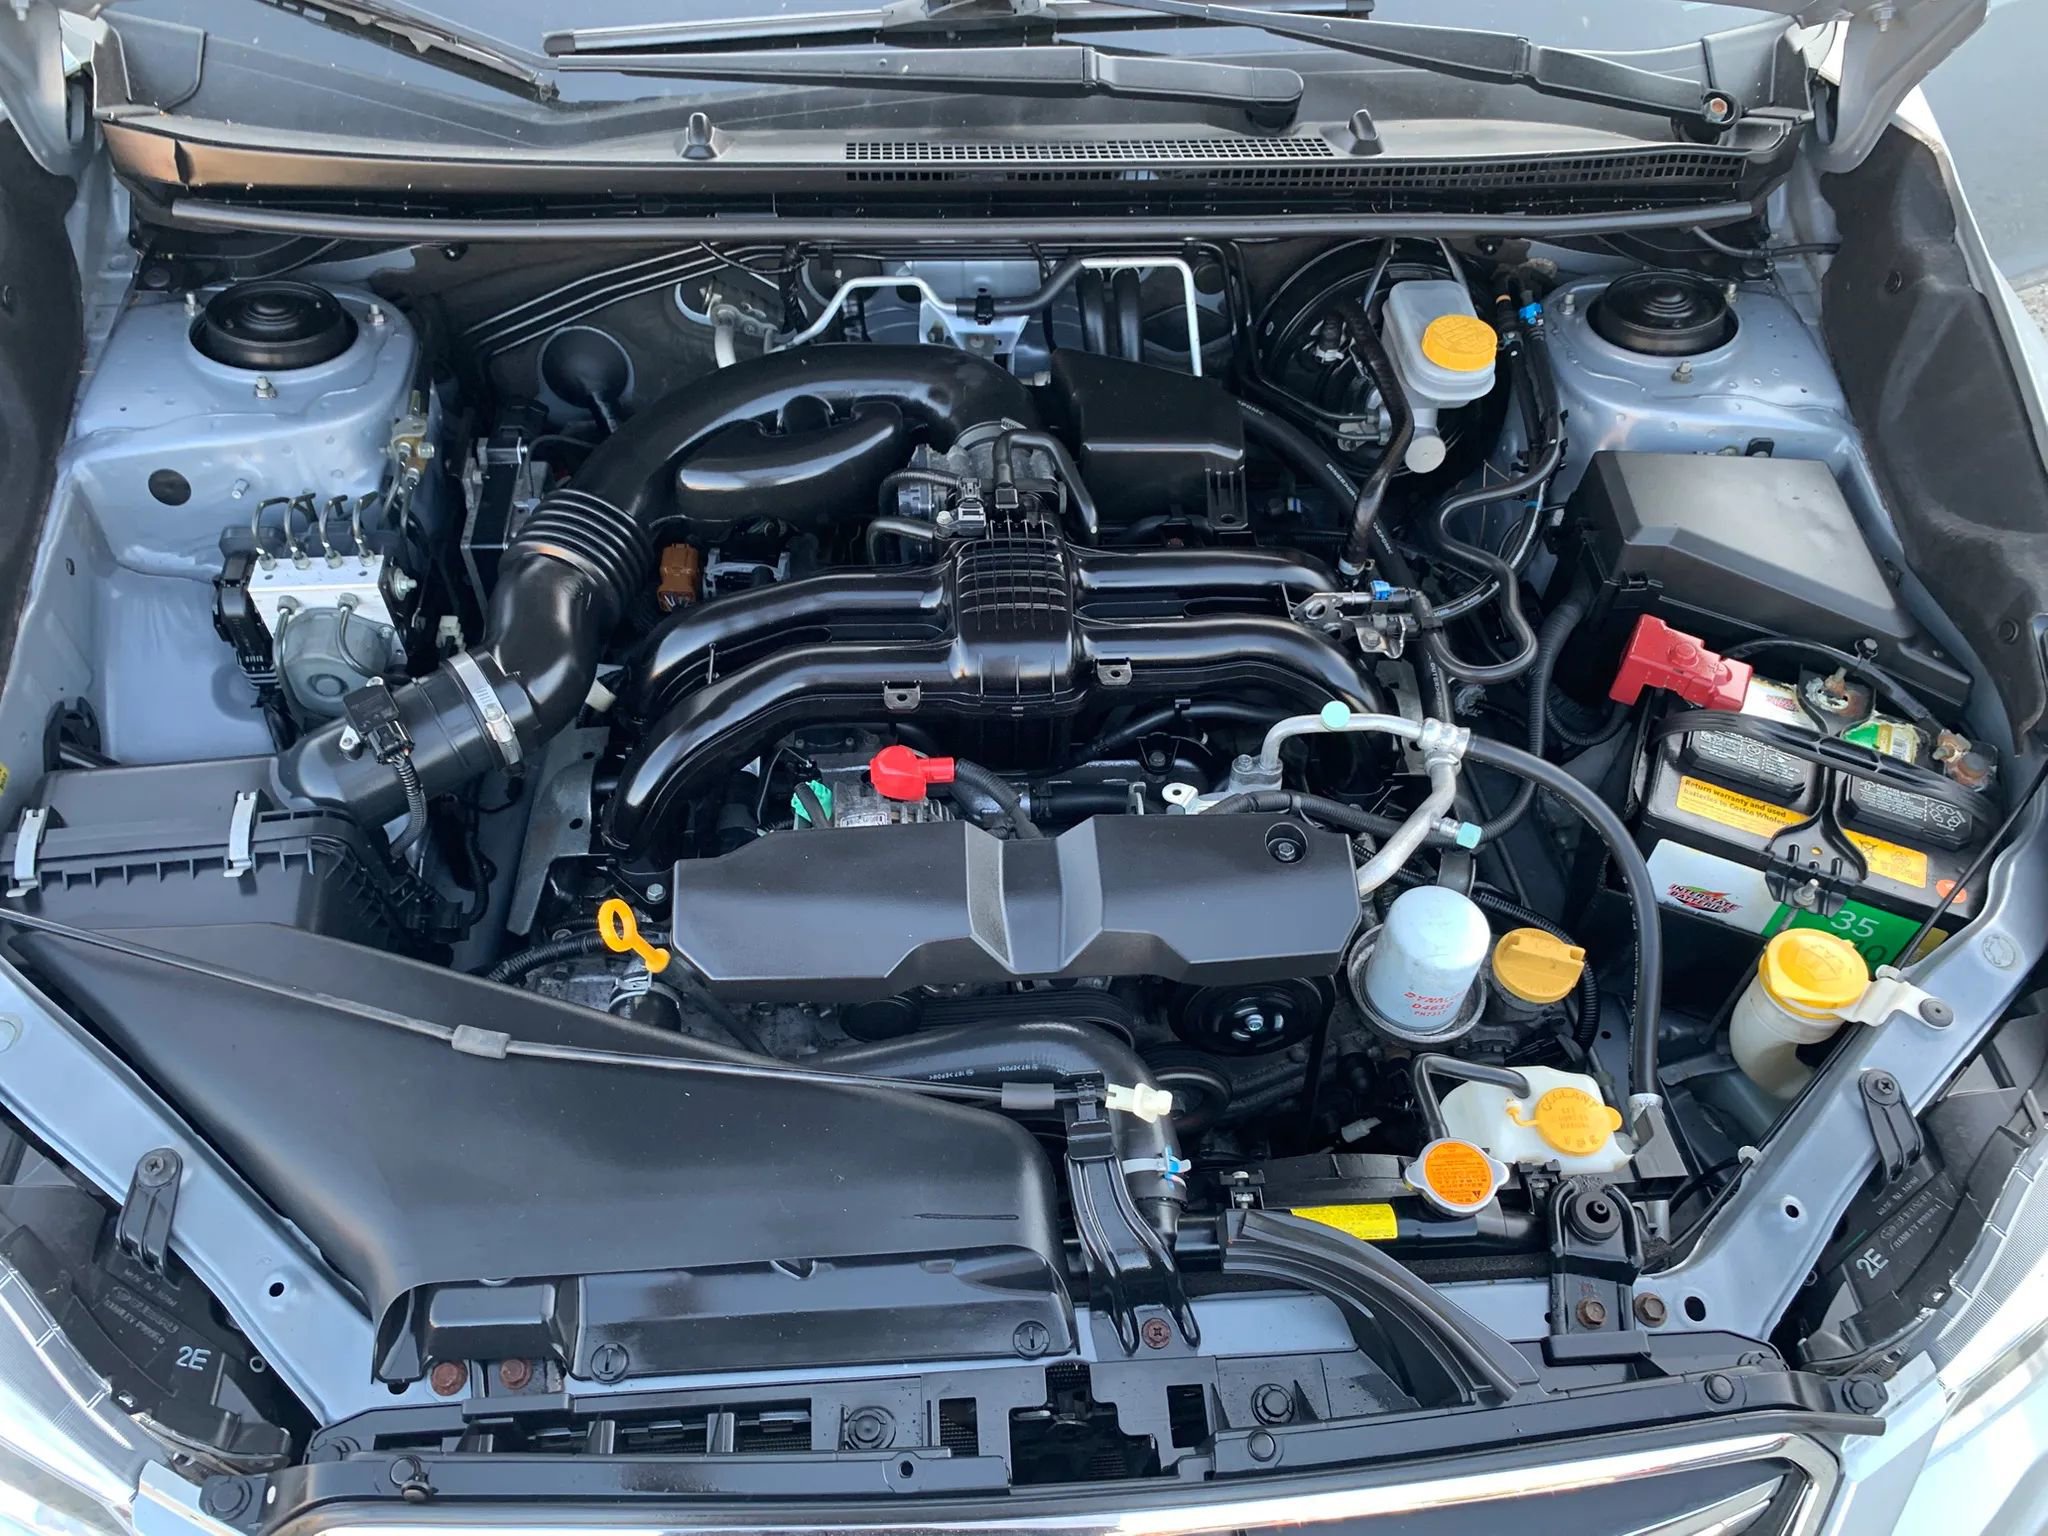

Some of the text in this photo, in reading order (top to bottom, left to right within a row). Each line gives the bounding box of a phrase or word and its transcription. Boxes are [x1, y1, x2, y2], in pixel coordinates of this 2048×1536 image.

[1684, 787, 1718, 804] batteries
[1719, 799, 1729, 808] to
[1729, 803, 1755, 816] Costco
[1685, 779, 1786, 818] Return warranty and used
[1667, 890, 1731, 914] BATTERIES
[1669, 883, 1742, 910] INTERSTATE
[1830, 910, 1880, 937] 35
[1856, 1247, 1889, 1279] 2E
[175, 1345, 212, 1371] 2E
